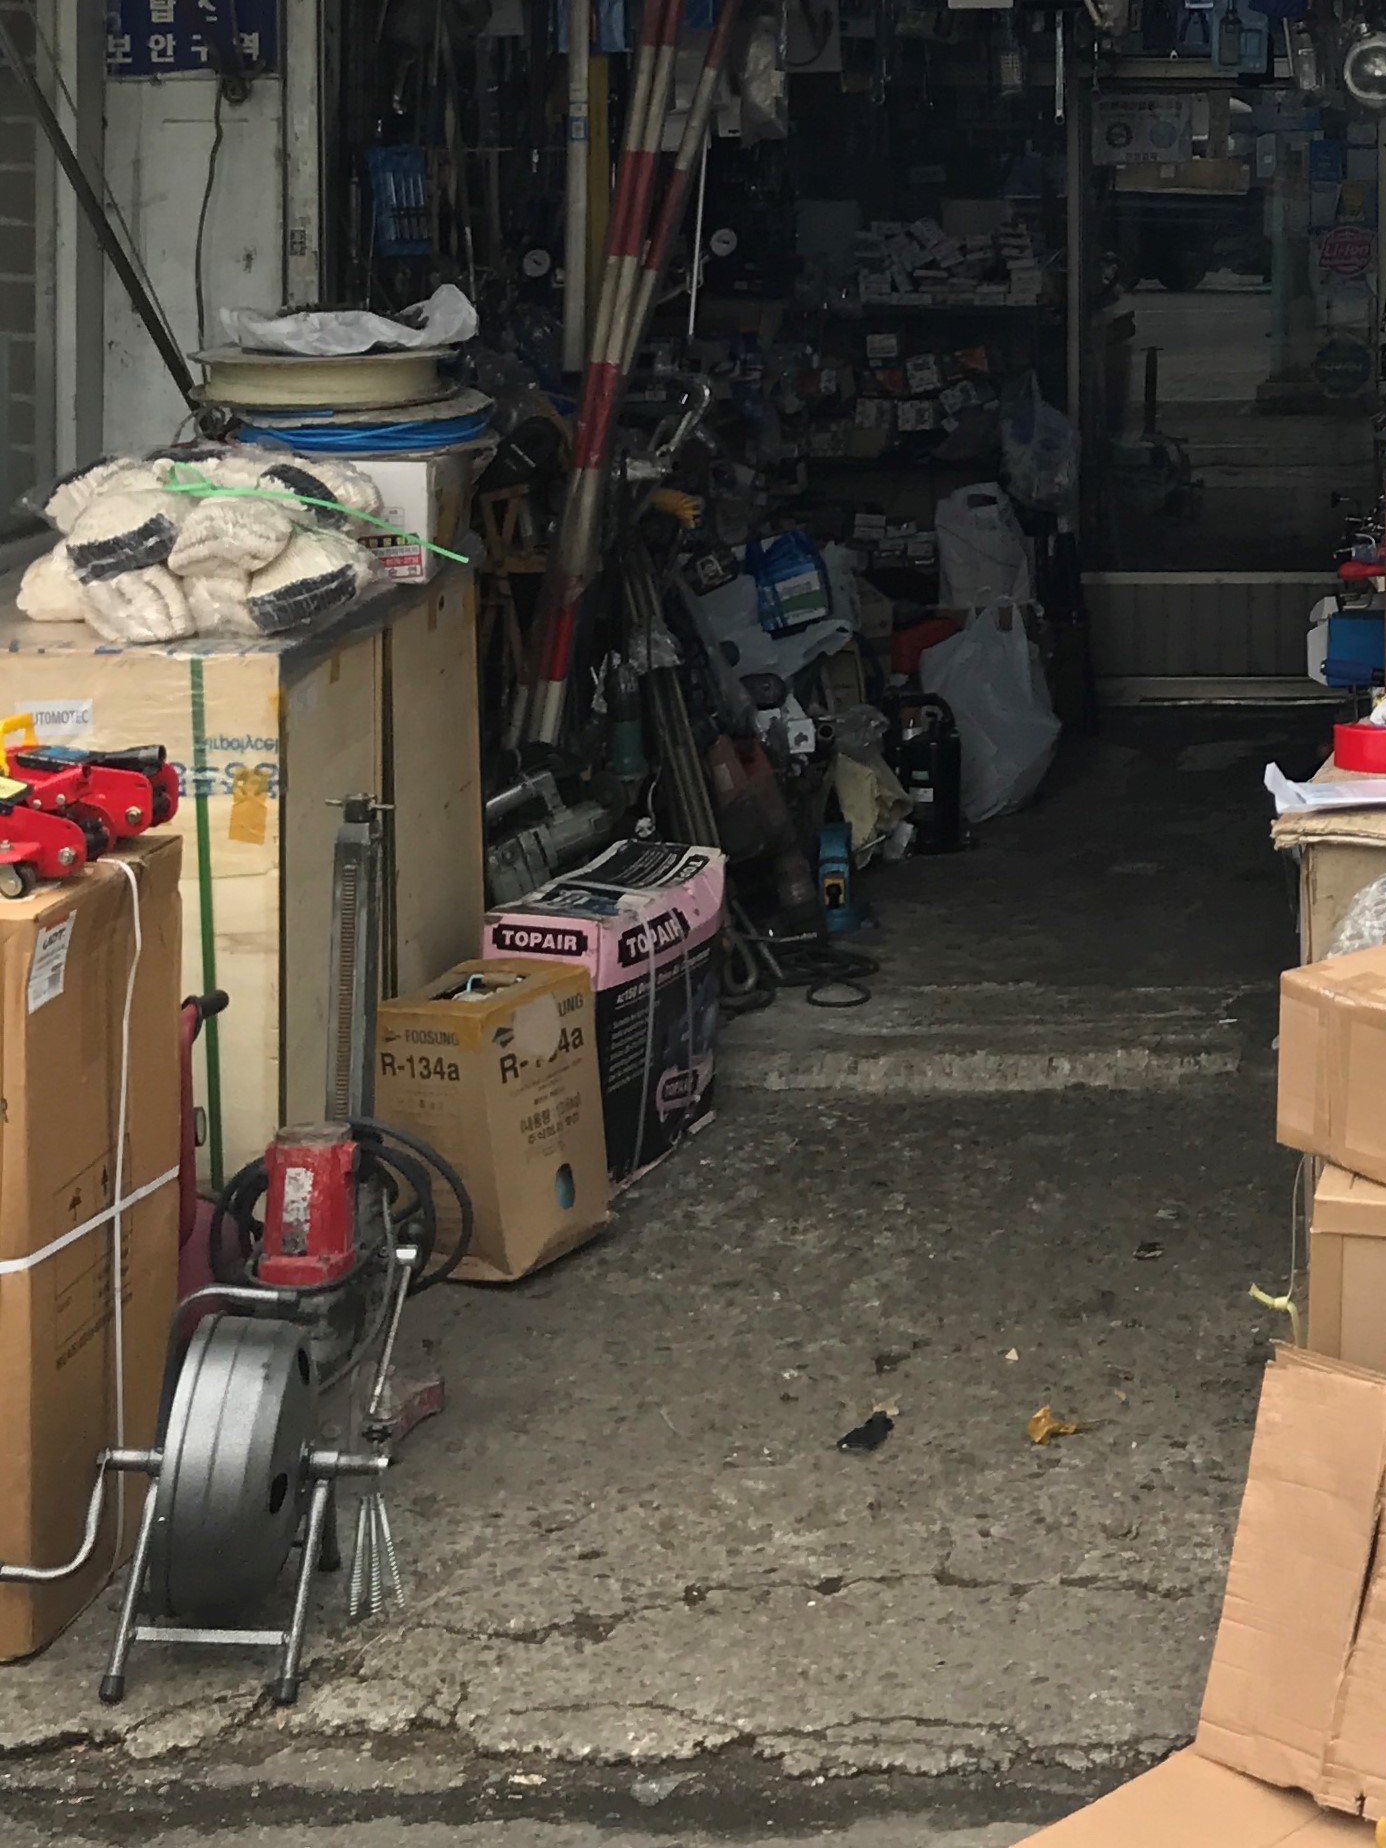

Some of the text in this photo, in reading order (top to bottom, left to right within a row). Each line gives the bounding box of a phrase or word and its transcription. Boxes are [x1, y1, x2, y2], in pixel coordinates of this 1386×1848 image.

[502, 929, 578, 951] TOPAIR
[380, 1053, 461, 1082] R-134a
[500, 1026, 584, 1084] R-4a
